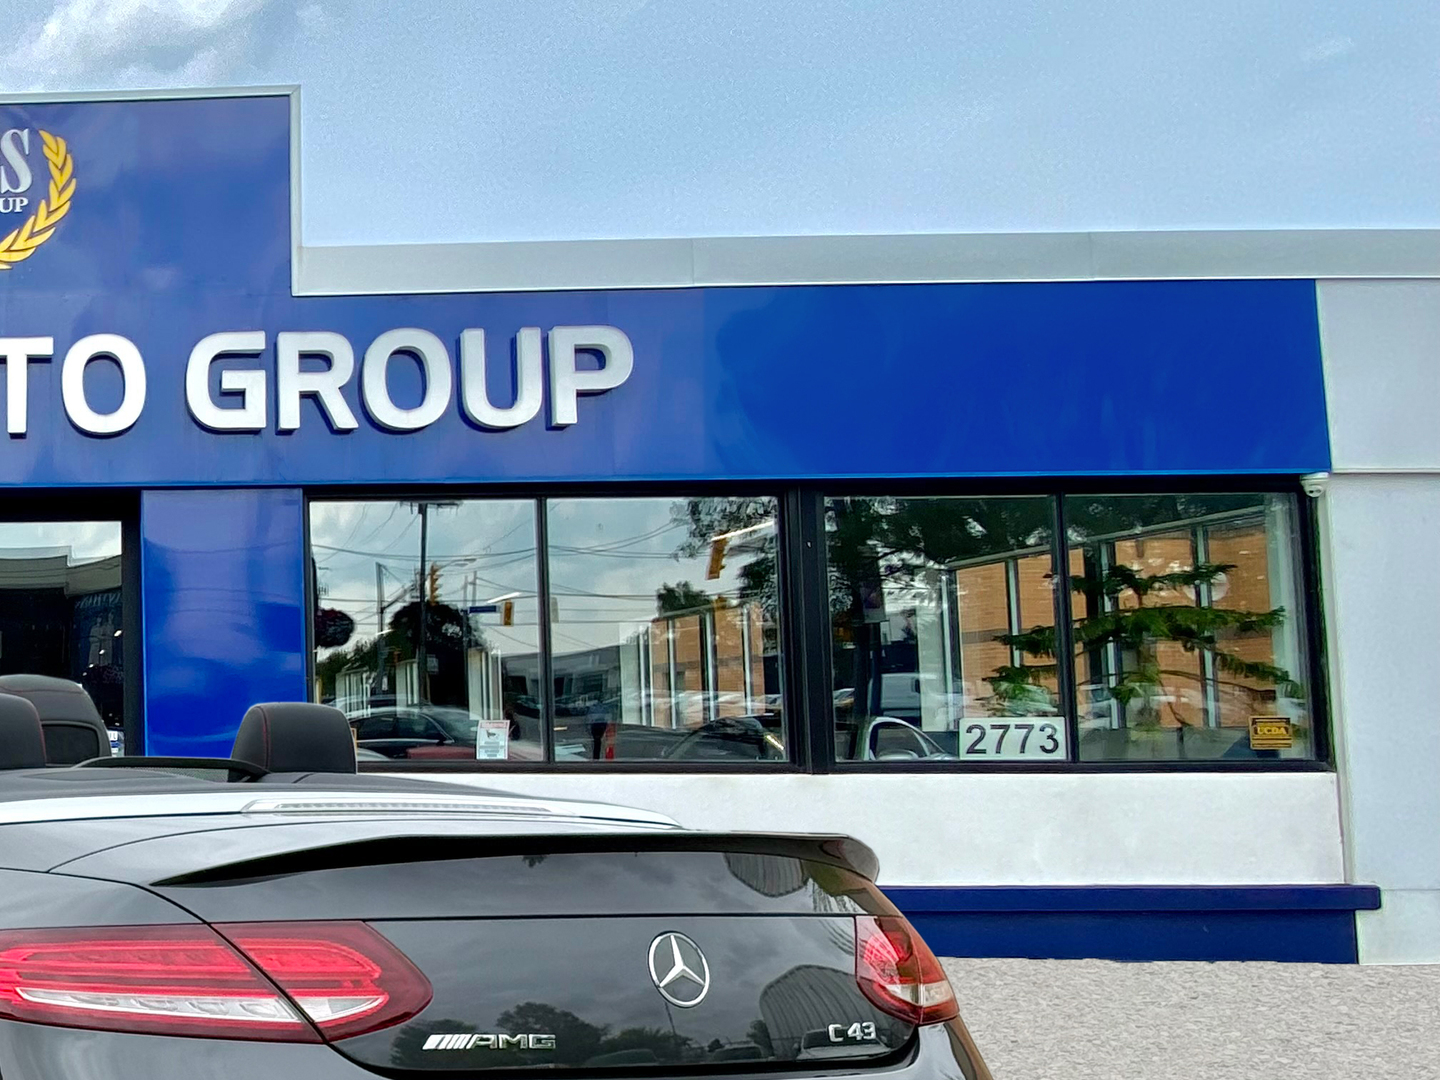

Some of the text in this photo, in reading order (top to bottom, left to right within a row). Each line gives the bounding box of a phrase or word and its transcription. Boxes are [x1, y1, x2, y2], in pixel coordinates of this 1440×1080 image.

[185, 325, 634, 432] GROUP
[966, 723, 1059, 754] 2773
[1257, 726, 1288, 735] UCDA
[465, 1033, 557, 1050] AMG
[828, 1021, 877, 1043] C 43
